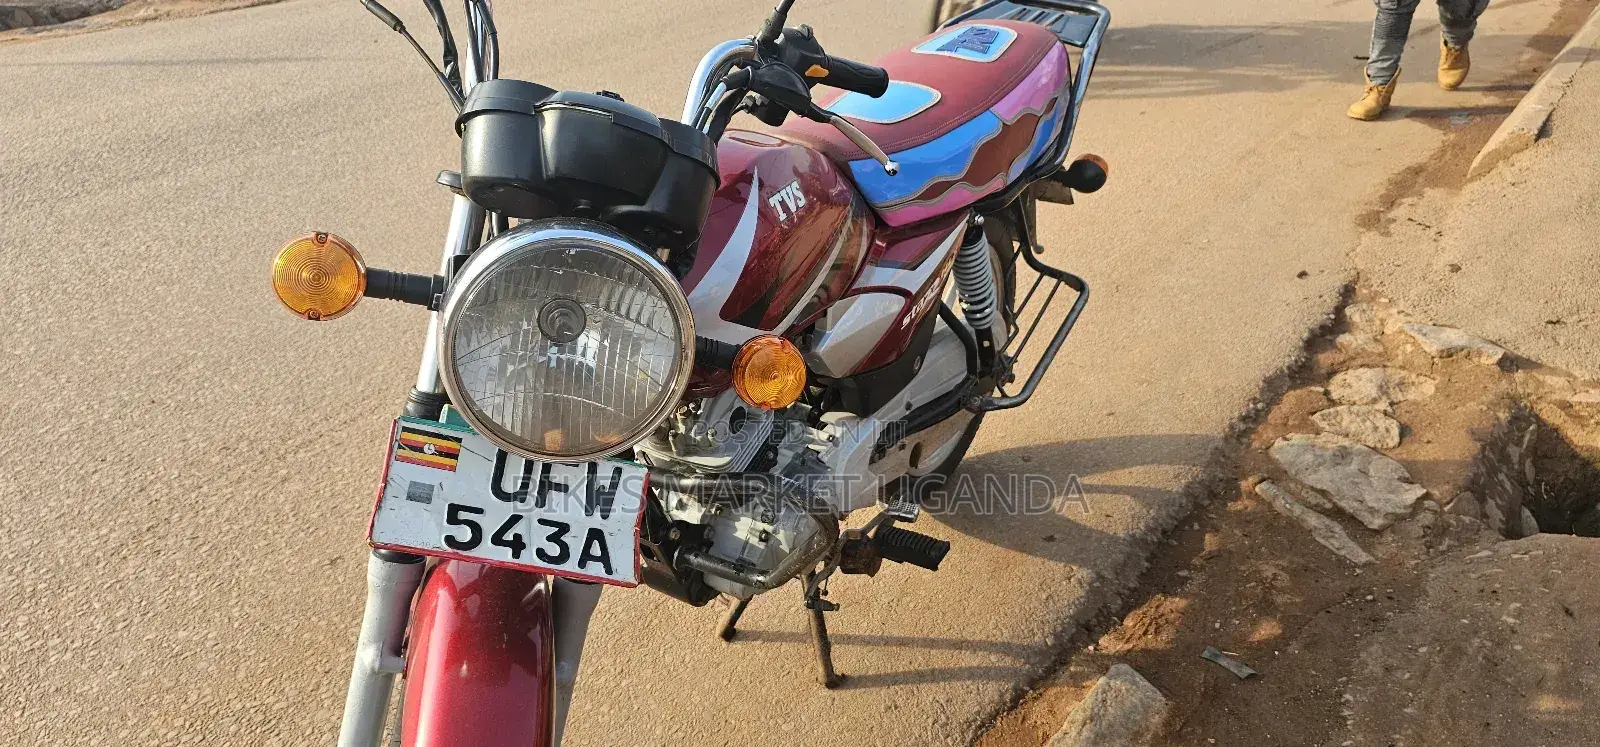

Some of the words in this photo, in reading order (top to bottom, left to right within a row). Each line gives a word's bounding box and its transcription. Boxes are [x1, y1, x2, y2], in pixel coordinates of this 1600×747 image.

[769, 181, 806, 222] TVS
[491, 448, 622, 519] UFW
[443, 502, 614, 575] 543A
